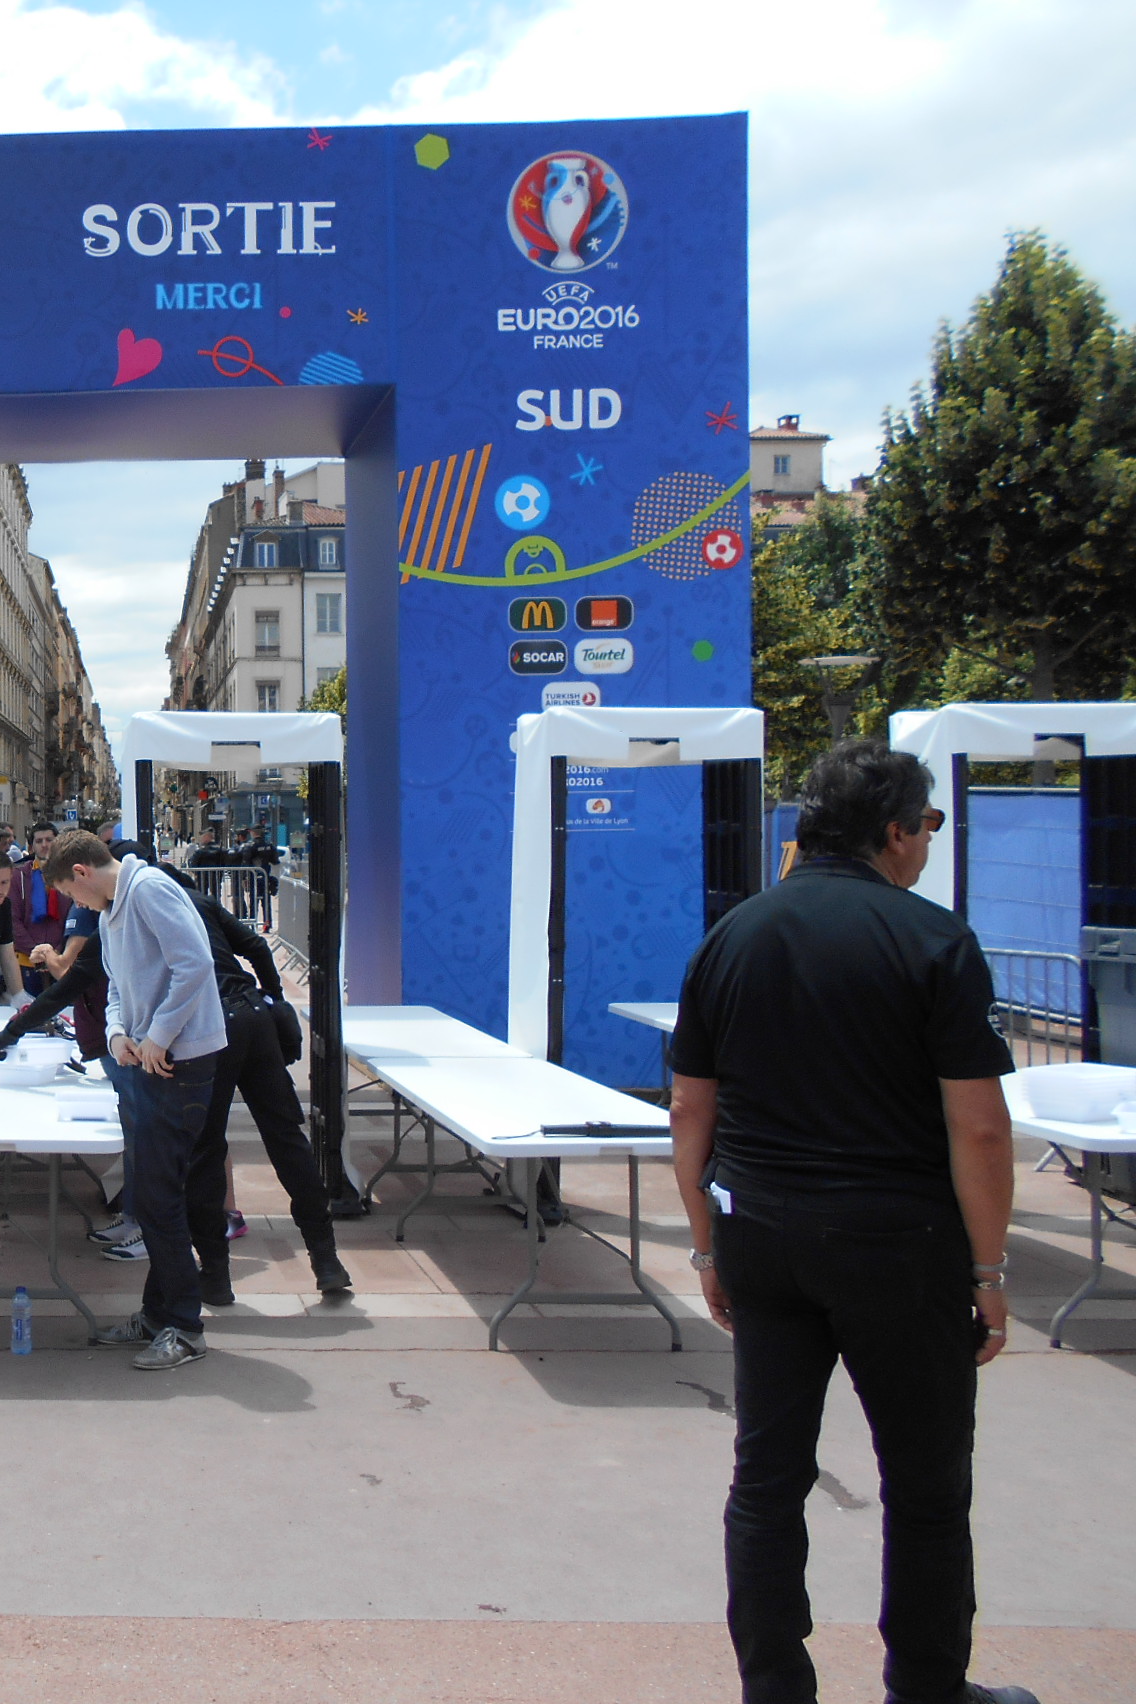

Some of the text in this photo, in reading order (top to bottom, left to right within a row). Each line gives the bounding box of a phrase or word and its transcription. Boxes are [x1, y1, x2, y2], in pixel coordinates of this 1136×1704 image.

[82, 200, 336, 256] SORTIE
[155, 282, 262, 310] MERCI
[545, 285, 590, 302] UEFA
[497, 305, 640, 331] EURO2016
[533, 334, 604, 349] FRANCE
[515, 388, 622, 431] SUD
[523, 652, 565, 663] SOCAR
[582, 648, 626, 661] Tourtel
